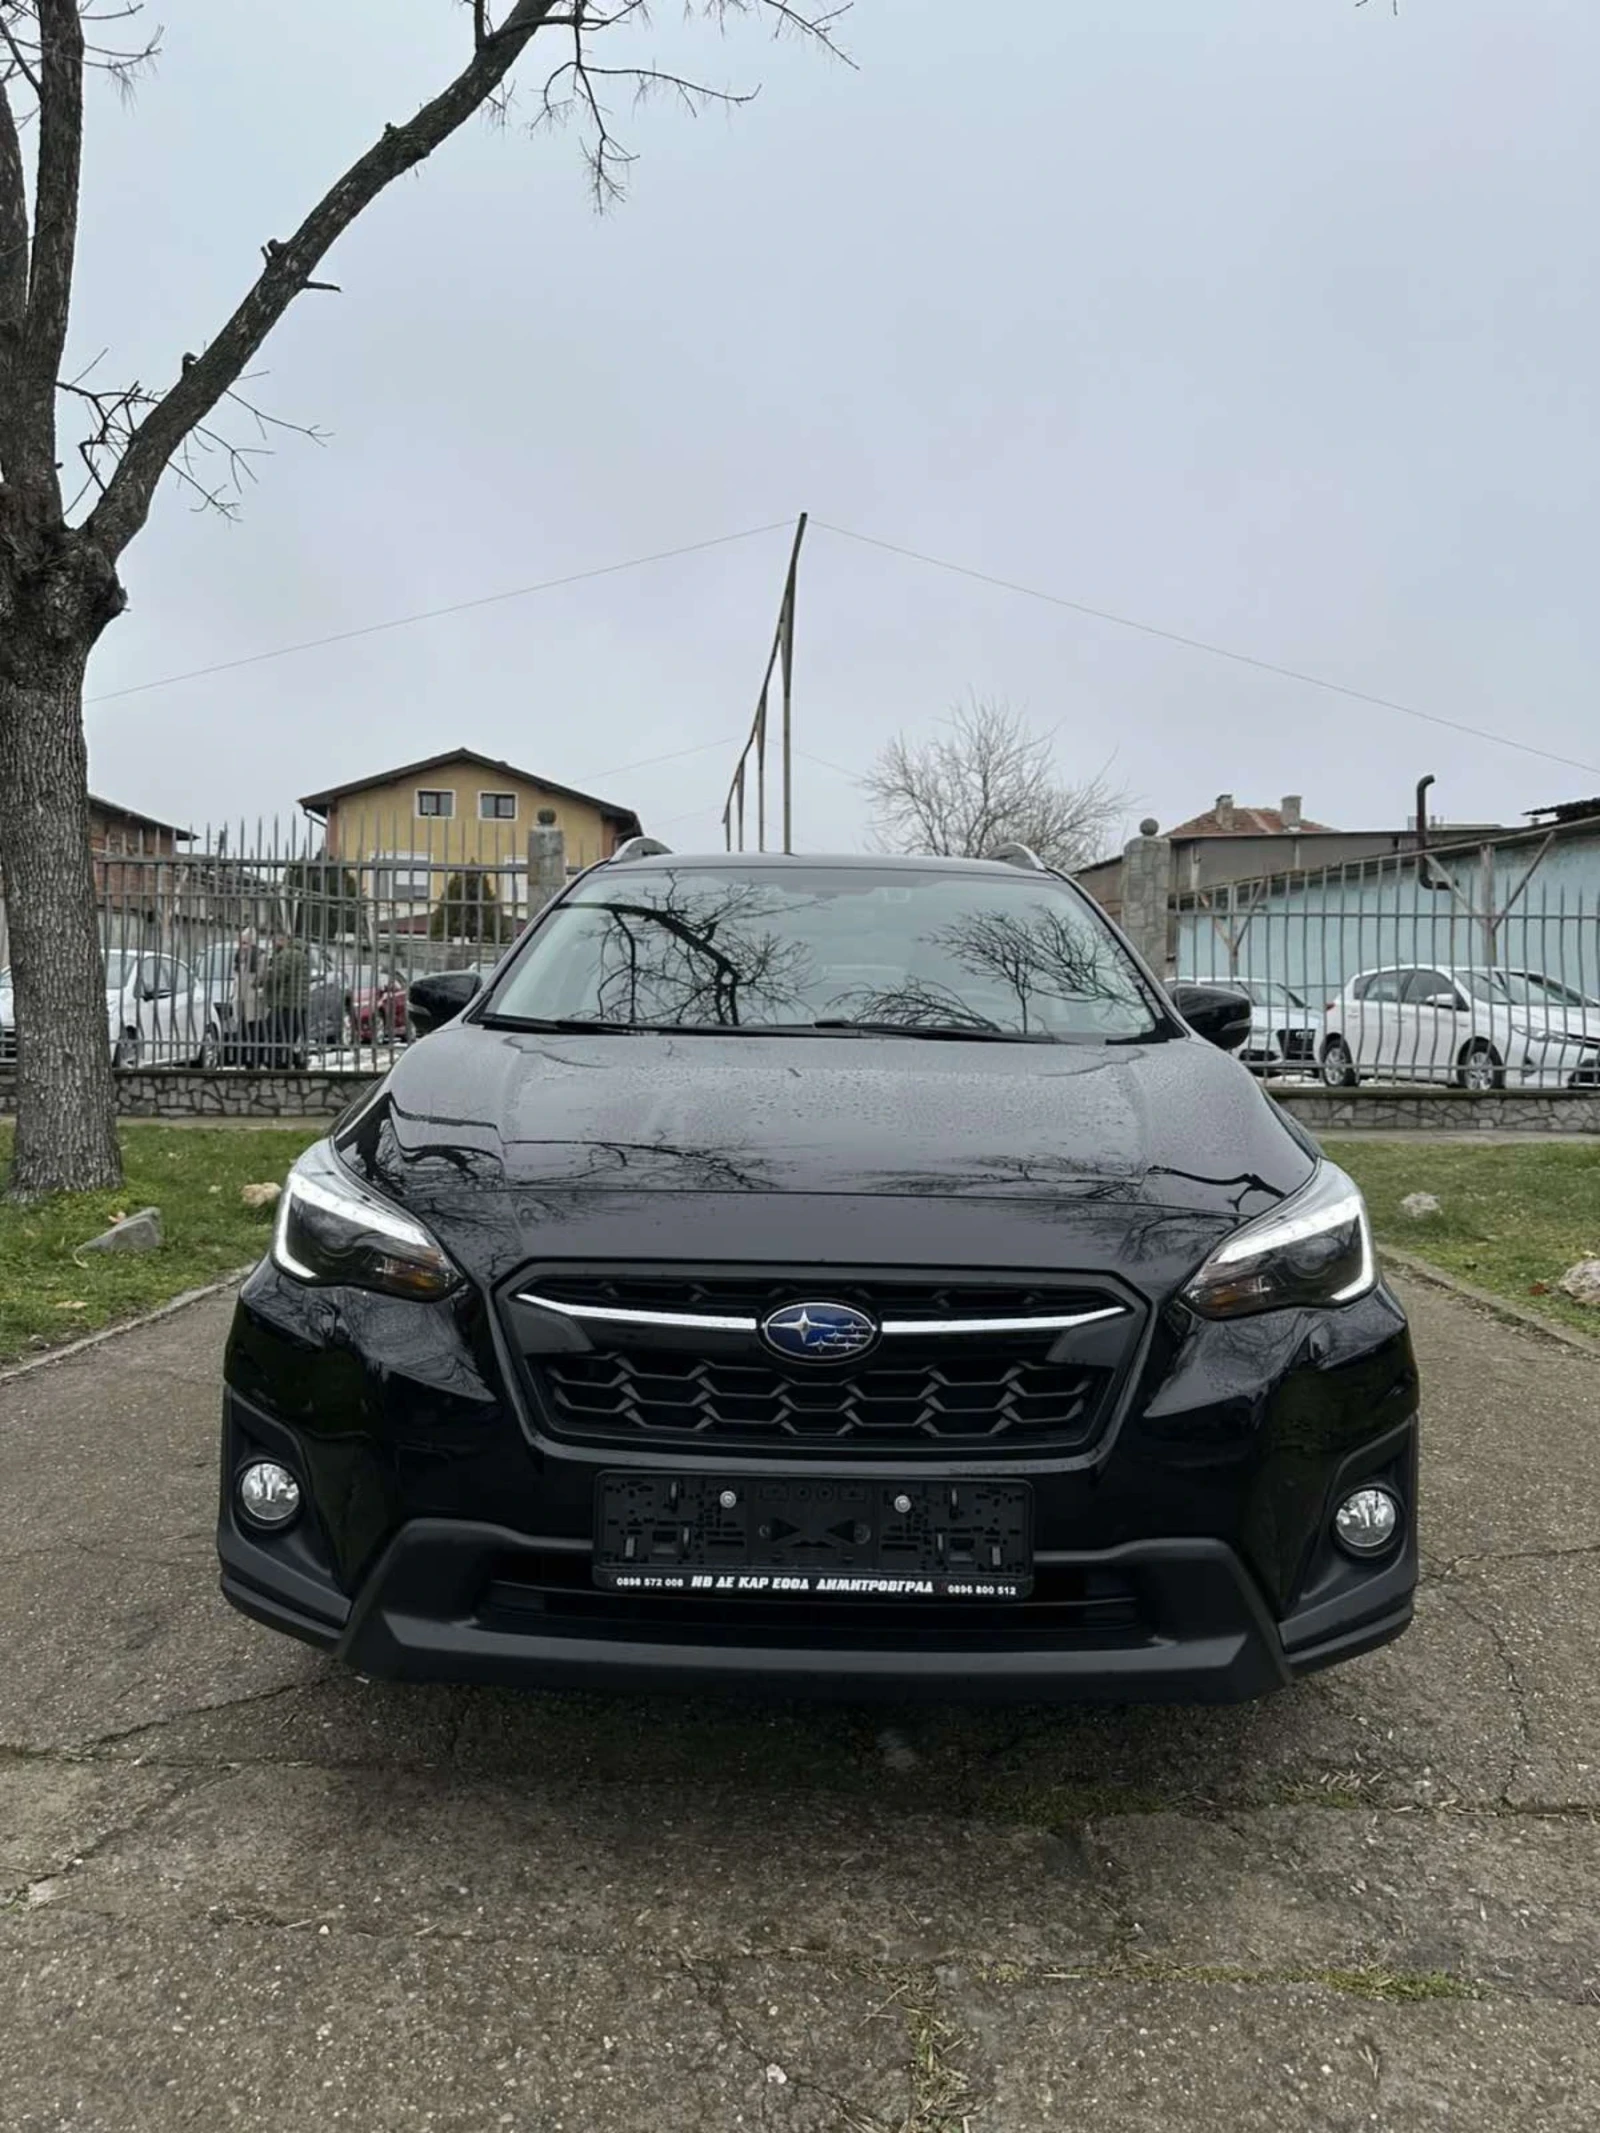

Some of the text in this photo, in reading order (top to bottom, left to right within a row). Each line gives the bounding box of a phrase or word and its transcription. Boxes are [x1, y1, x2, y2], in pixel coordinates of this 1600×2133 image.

[715, 1576, 736, 1589] ДЕ
[737, 1576, 770, 1589] КАР
[771, 1577, 810, 1590] ЕООД
[815, 1578, 934, 1593] ДИМИТРОВГРАД
